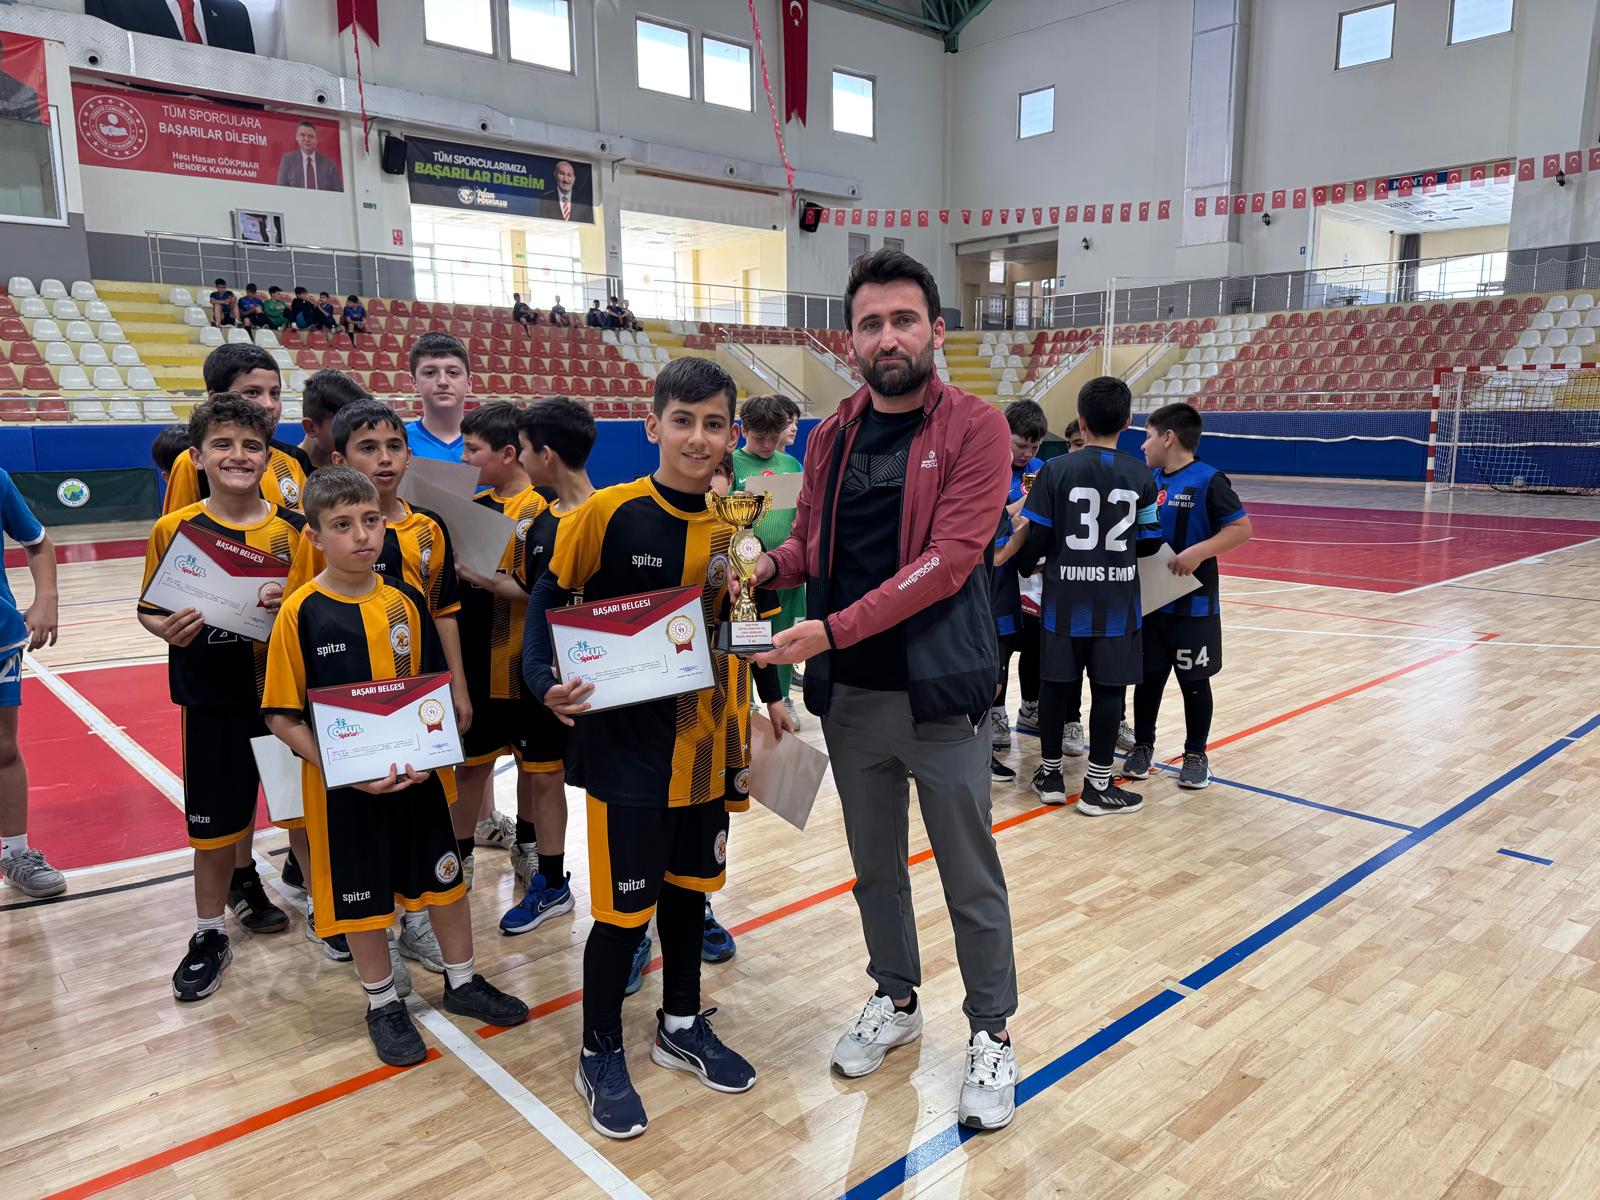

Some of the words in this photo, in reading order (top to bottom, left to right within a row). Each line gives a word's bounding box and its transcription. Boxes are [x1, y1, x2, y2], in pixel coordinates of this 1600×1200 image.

[162, 105, 187, 120] TÜM
[189, 109, 261, 130] SPORCULARA
[158, 122, 222, 142] BAŞARILAR
[225, 130, 267, 146] DİLERİM
[172, 151, 190, 162] Hacı
[191, 153, 216, 165] Hasan
[217, 156, 259, 170] GÖKPINAR
[173, 161, 207, 173] HENDEK
[209, 165, 257, 178] KAYMAKAMI
[433, 151, 452, 164] TÜM
[453, 154, 527, 174] SPORCULARIMIZA
[415, 162, 491, 182] BAŞARILAR
[493, 171, 545, 190] DİLERİM
[1065, 487, 1140, 552] 32
[215, 539, 240, 556] BAŞARI
[239, 547, 265, 564] BELGESİ
[631, 553, 663, 568] spitze
[1060, 565, 1105, 582] YUNUS
[1108, 564, 1136, 582] EMR
[592, 604, 620, 617] BAŞARI
[621, 597, 651, 611] BELGESİ
[316, 642, 346, 657] spitze
[1176, 645, 1210, 671] 54
[351, 686, 377, 698] BAŞARI
[378, 681, 405, 694] BELGESİ
[189, 813, 211, 824] spitze
[618, 878, 646, 894] spitze
[342, 890, 371, 904] spitze
